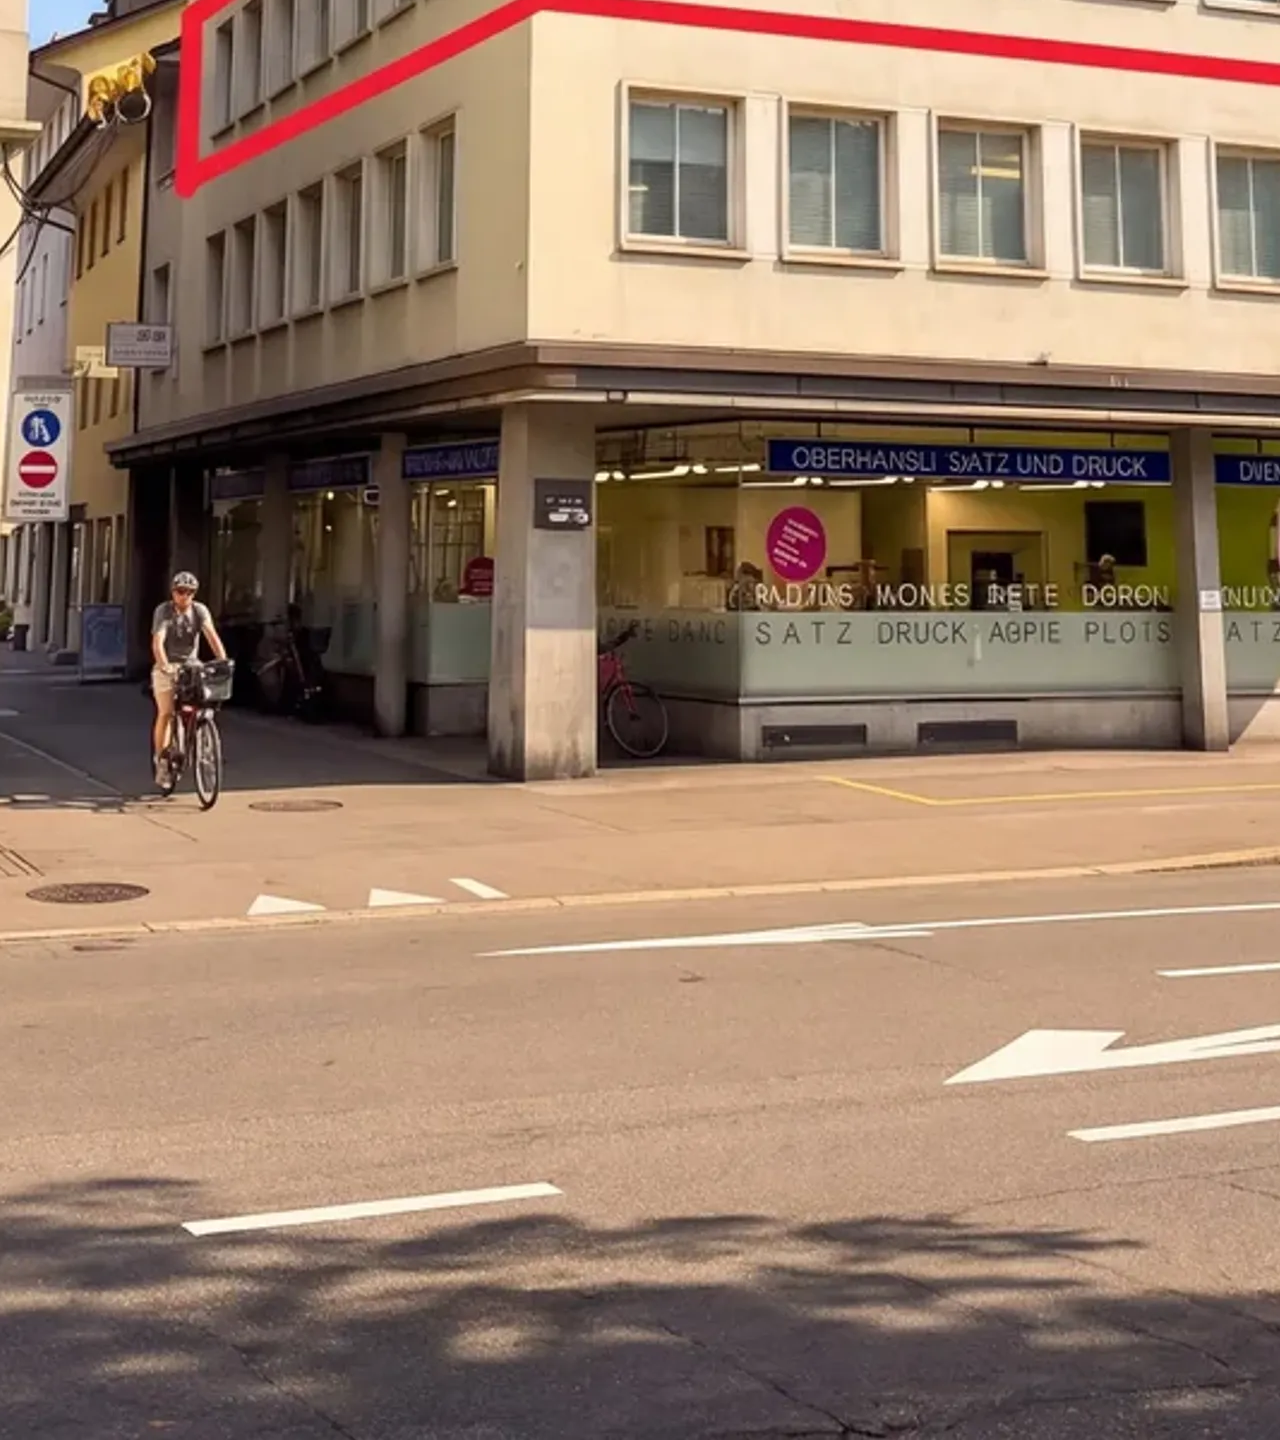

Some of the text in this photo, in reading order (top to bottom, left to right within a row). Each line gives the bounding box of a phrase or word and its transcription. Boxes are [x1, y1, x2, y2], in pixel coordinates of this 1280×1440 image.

[1016, 452, 1064, 475] UND
[1072, 455, 1148, 477] DRUCK
[755, 621, 852, 644] SATZ
[878, 621, 968, 644] DRUCK
